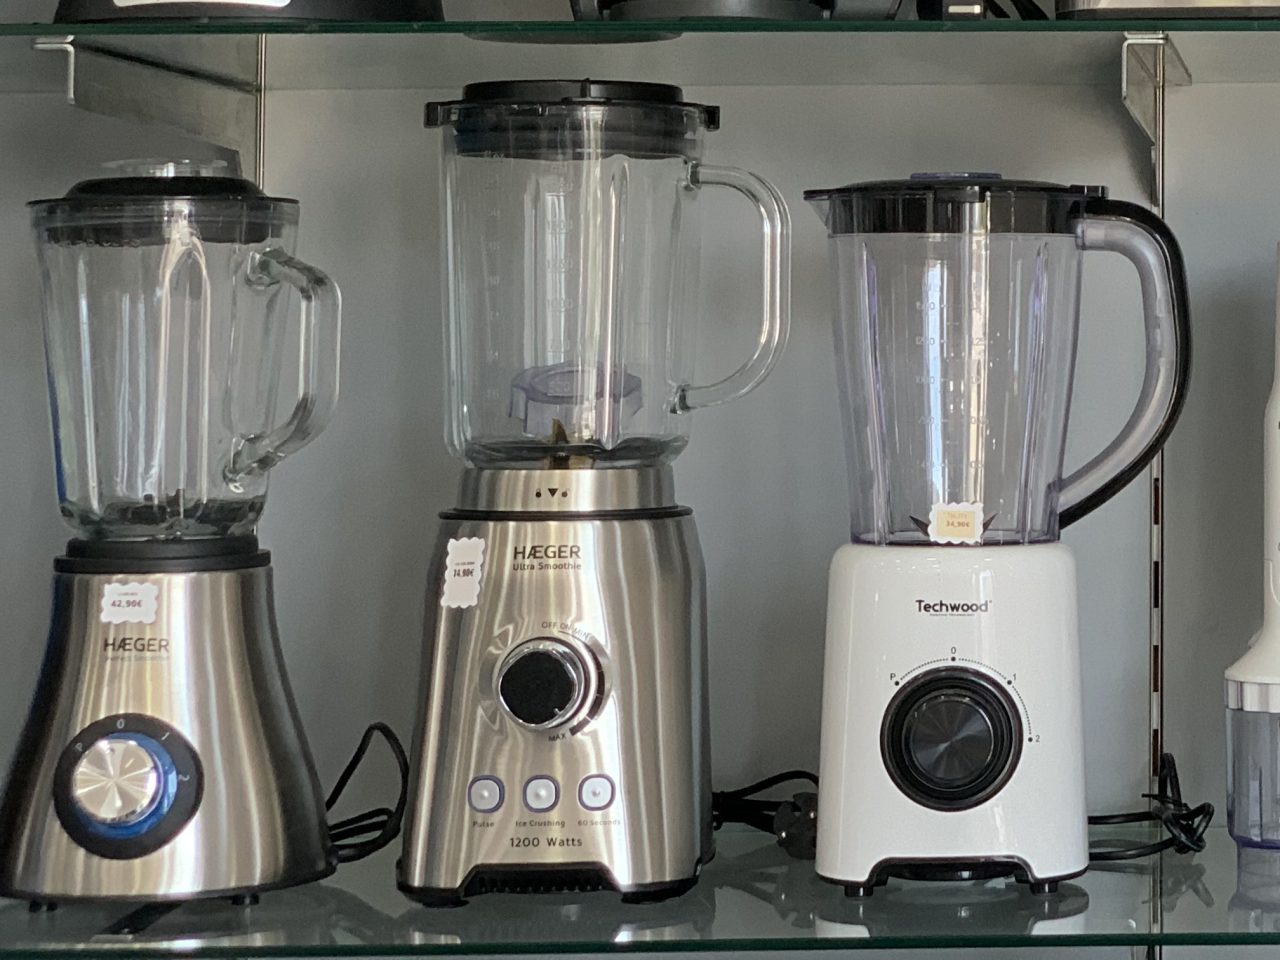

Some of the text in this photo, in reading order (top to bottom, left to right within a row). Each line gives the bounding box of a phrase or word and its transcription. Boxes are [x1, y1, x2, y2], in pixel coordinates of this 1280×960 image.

[513, 544, 582, 559] HÆGER
[513, 562, 582, 572] Ultra Smoothie
[111, 599, 142, 609] 42,90€
[915, 599, 989, 614] Techwood
[541, 621, 557, 629] OFF
[104, 637, 169, 652] HÆGER
[548, 732, 567, 742] MAX
[472, 820, 495, 828] Pulse
[515, 819, 565, 830] Ice Crushing
[509, 837, 583, 848] 1200 Watts
